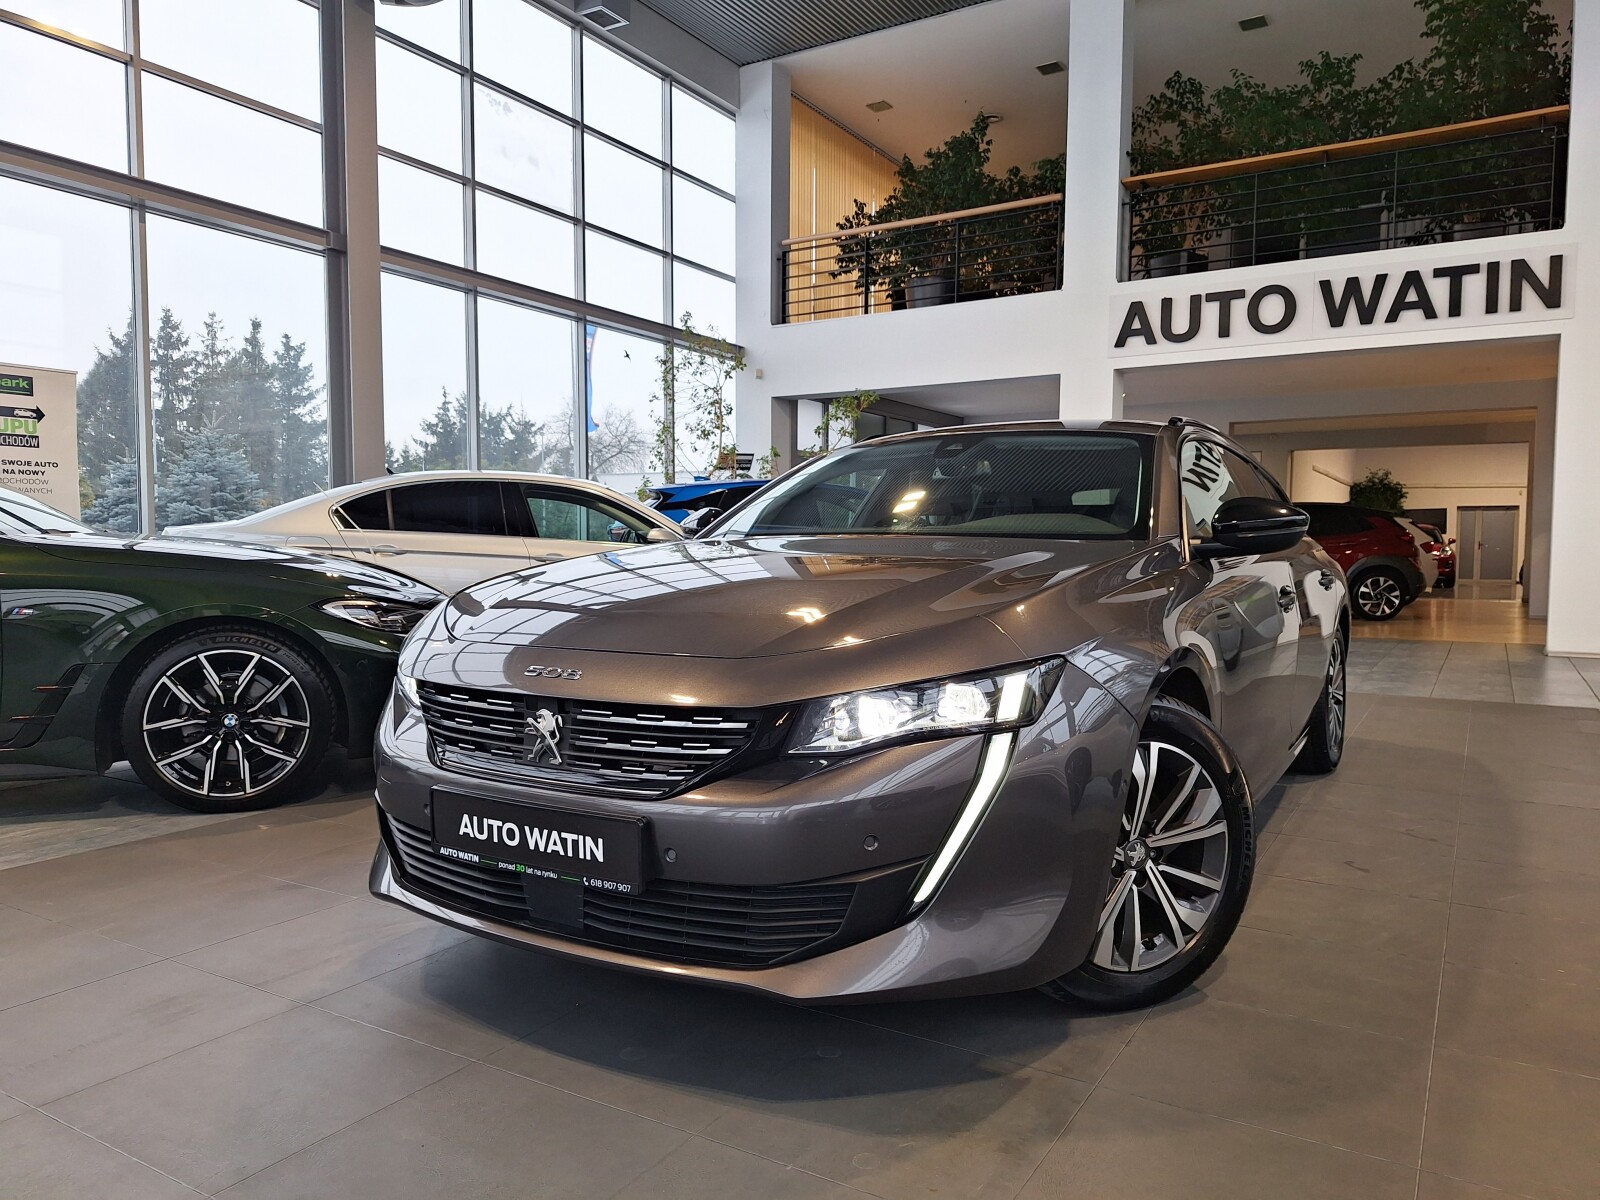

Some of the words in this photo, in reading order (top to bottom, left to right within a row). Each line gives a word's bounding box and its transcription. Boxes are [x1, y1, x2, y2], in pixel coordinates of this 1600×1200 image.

[1114, 284, 1297, 348] AUTO
[1318, 254, 1564, 328] WATIN
[0, 378, 30, 389] ark
[0, 435, 38, 447] CHODÓW
[1, 459, 32, 467] SWOJE
[215, 636, 278, 651] MICHELIN
[524, 665, 583, 680] 508
[459, 814, 520, 847] AUTO
[524, 825, 604, 863] WATIN
[440, 847, 458, 858] AUTO
[458, 851, 480, 863] WATIN
[498, 861, 516, 871] ponad
[516, 863, 525, 873] 30
[526, 866, 534, 874] lat
[534, 868, 542, 876] na
[542, 869, 558, 879] rynku
[590, 878, 603, 888] 618
[603, 881, 617, 890] 907
[617, 883, 632, 893] 907
